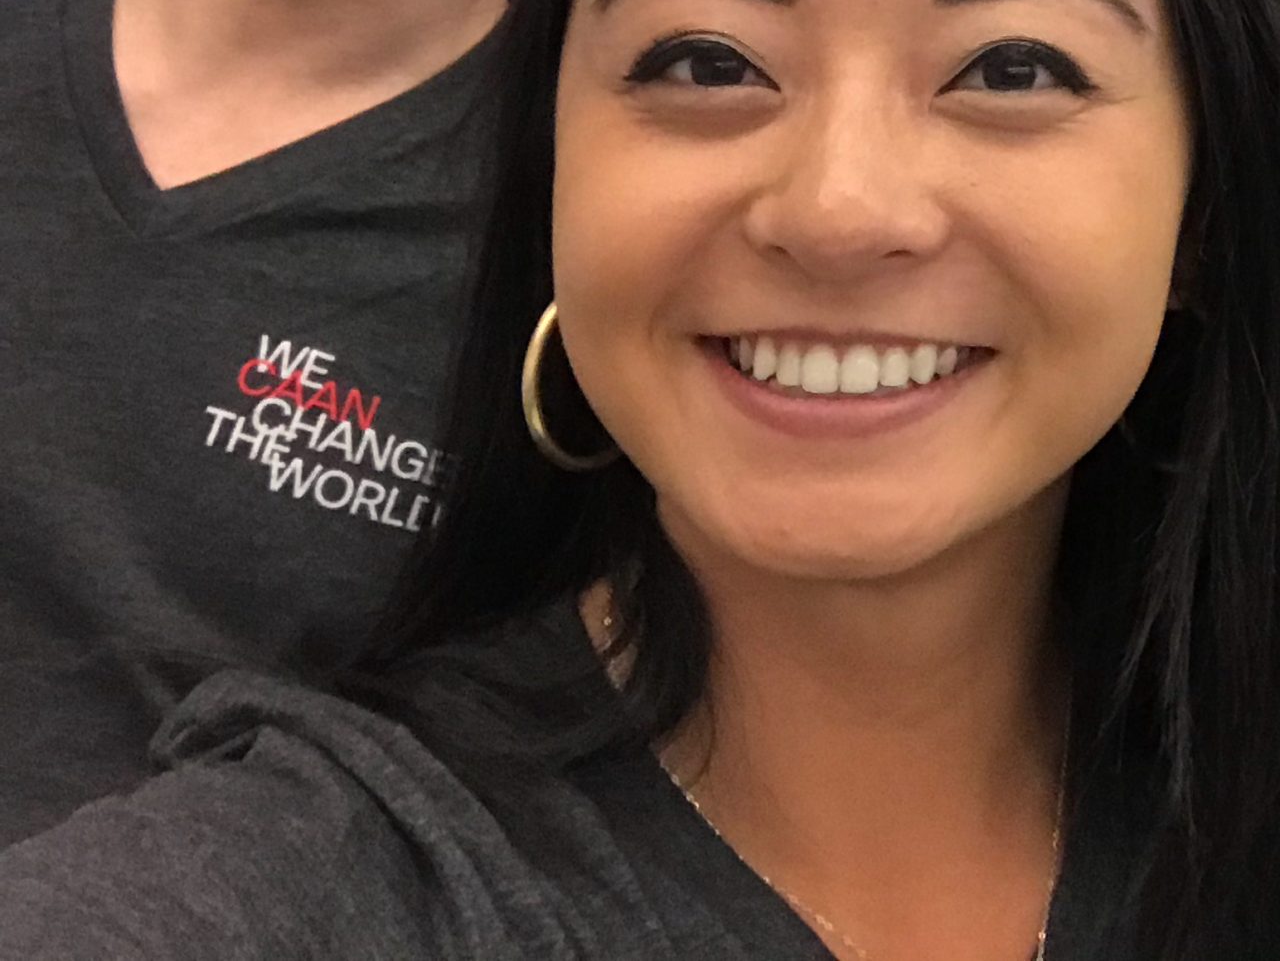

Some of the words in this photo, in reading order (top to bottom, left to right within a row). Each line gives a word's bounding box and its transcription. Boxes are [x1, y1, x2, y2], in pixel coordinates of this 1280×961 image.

[257, 334, 336, 390] WE
[237, 357, 382, 431] CAAN
[205, 404, 297, 467] THE
